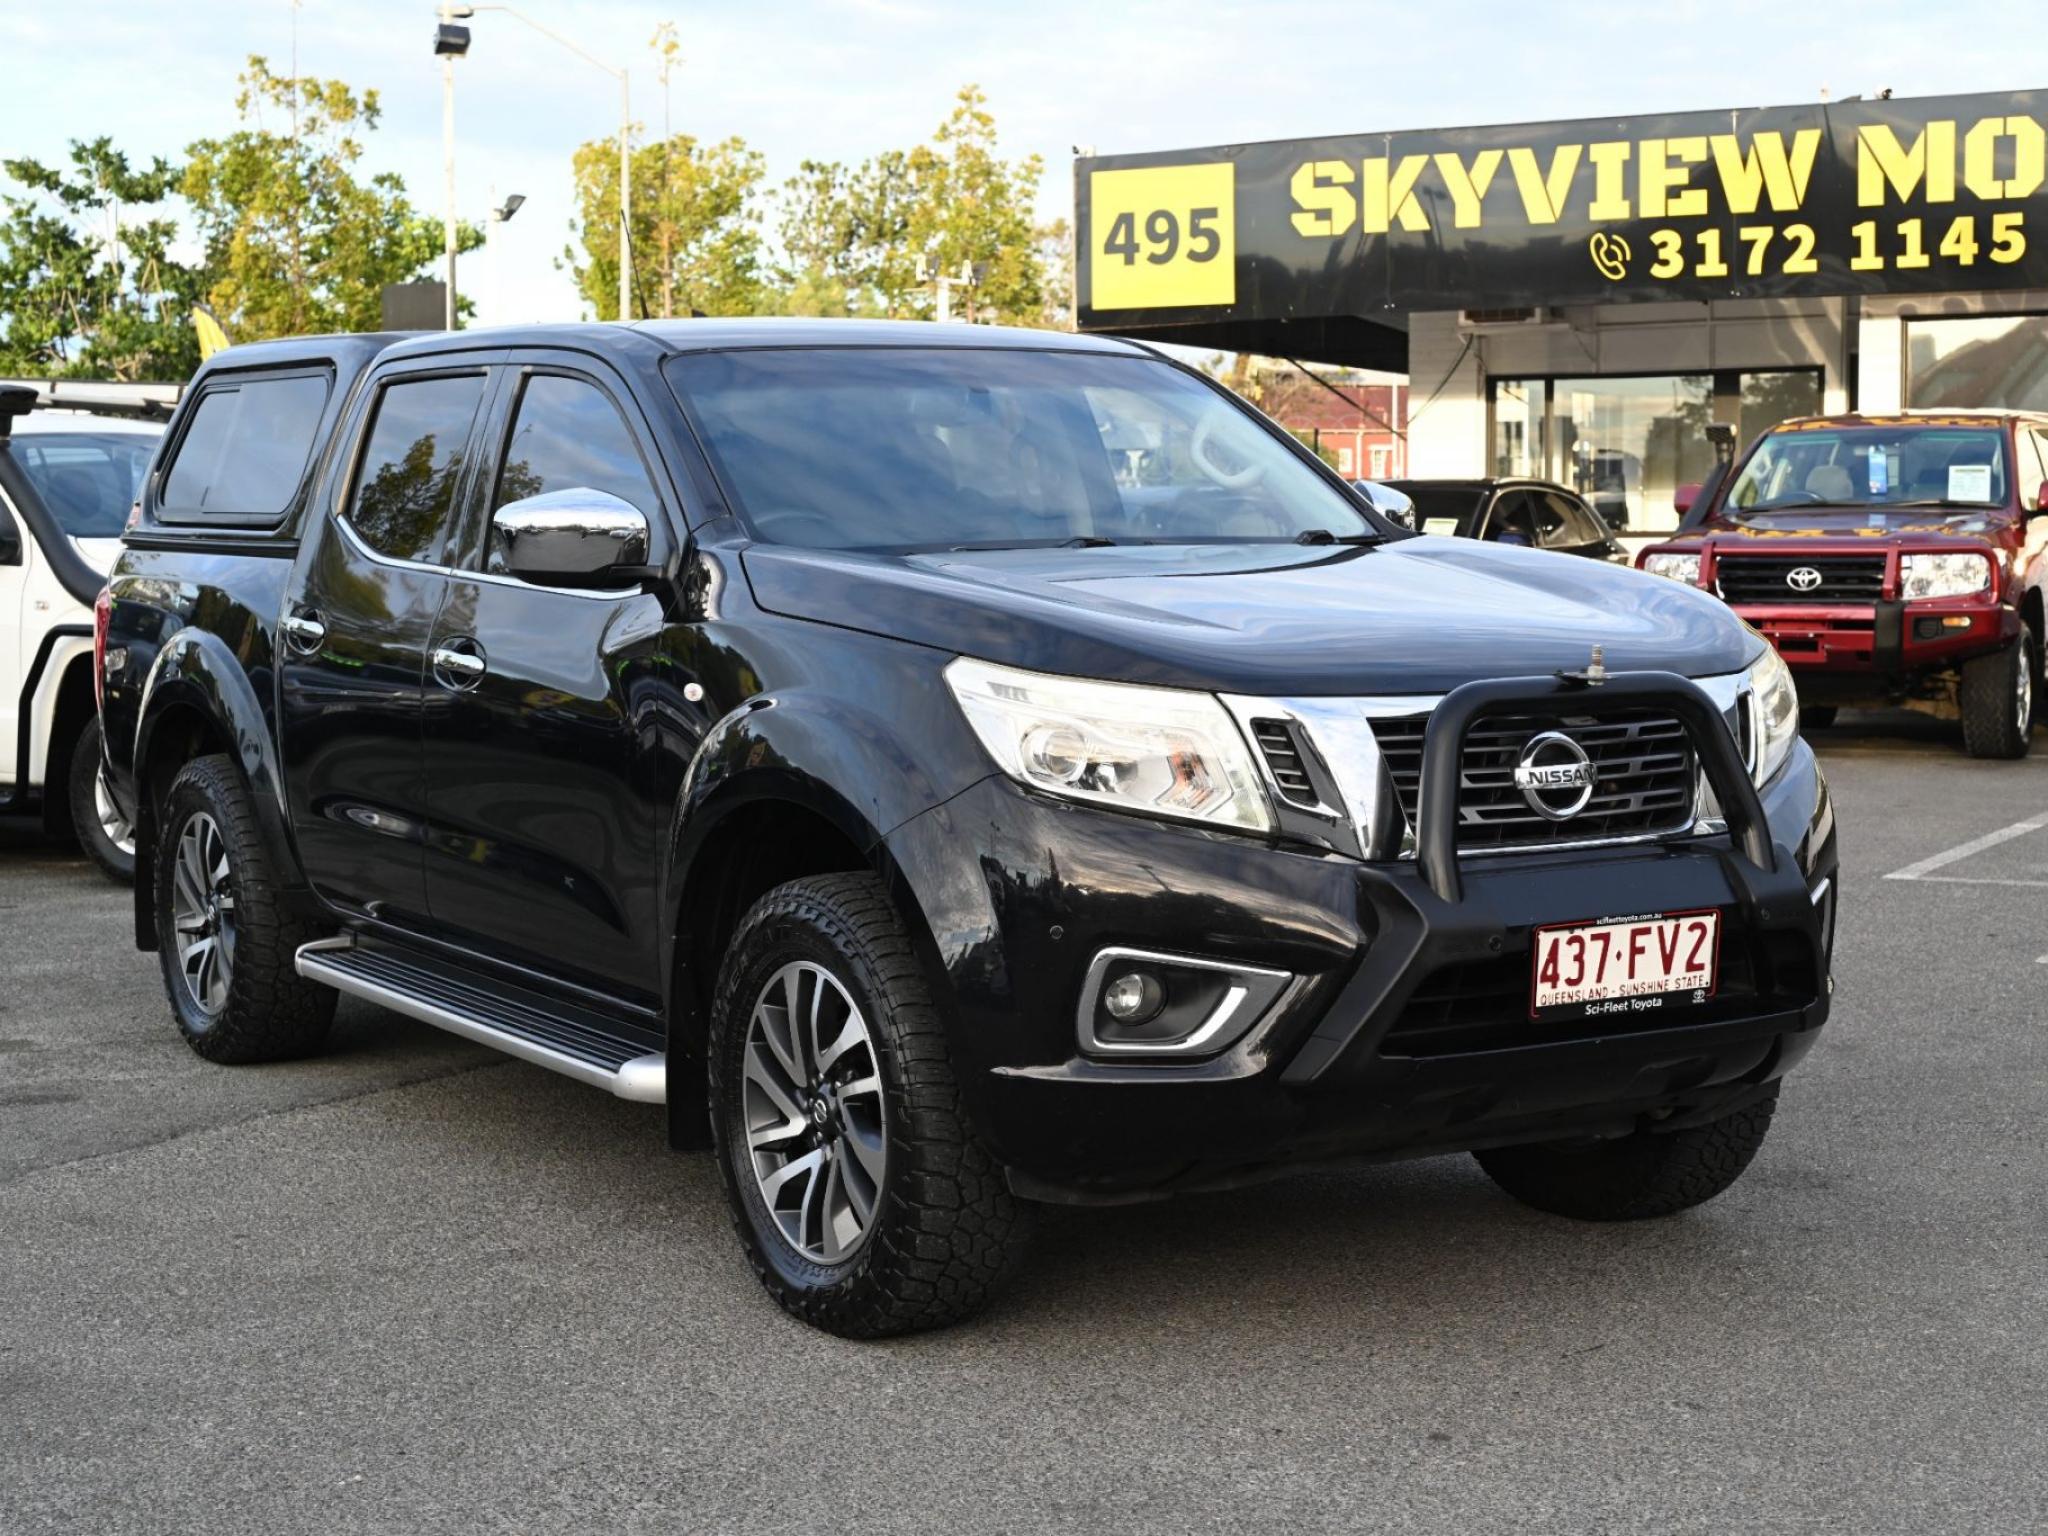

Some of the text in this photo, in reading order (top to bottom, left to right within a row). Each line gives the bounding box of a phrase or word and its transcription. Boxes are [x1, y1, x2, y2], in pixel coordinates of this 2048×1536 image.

[1290, 115, 2046, 237] SKYVIEW MO
[1103, 206, 1221, 266] 495
[1649, 211, 2026, 279] 3172 1145
[1528, 767, 1595, 784] NISSAN
[1540, 987, 1608, 1005] QUEENSLAND
[1619, 980, 1669, 996] SUNSHINE
[1675, 975, 1704, 988] STATE
[1585, 997, 1663, 1016] Sci-Fleet Toyota
